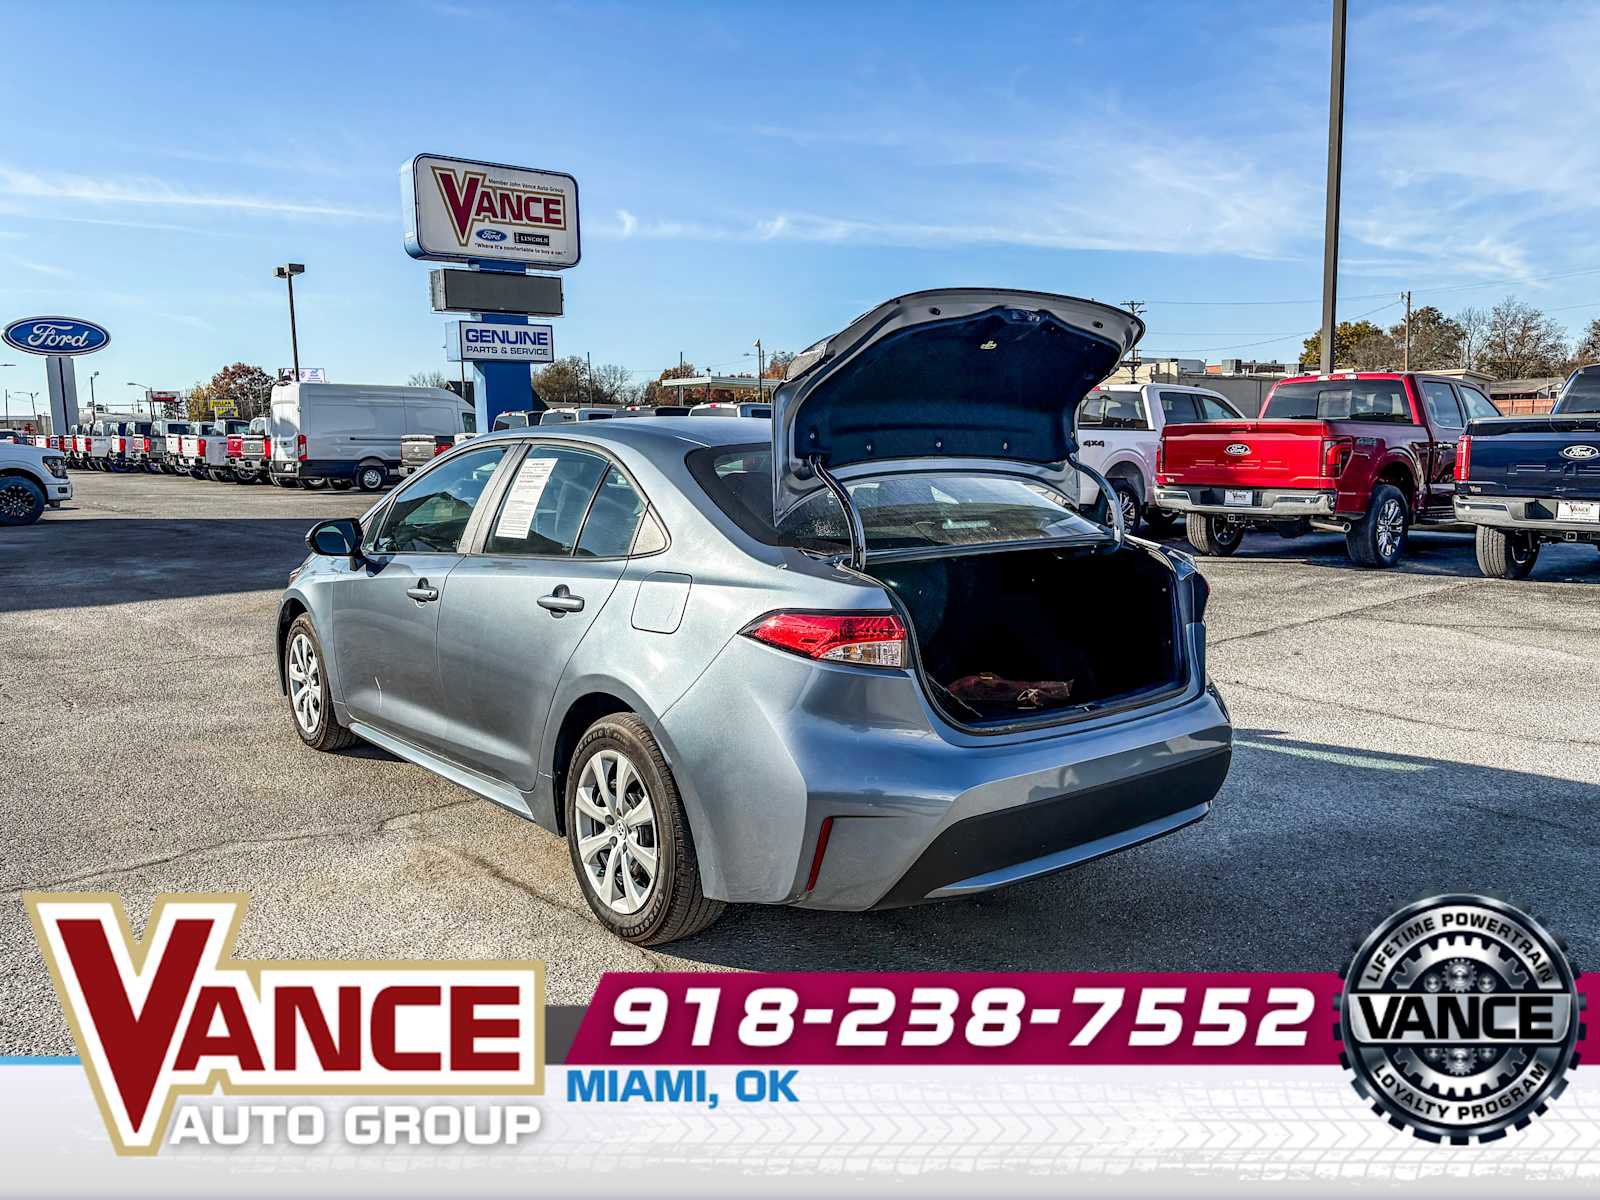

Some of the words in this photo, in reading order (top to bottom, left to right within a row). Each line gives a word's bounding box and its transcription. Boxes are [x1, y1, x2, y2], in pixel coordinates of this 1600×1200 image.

[437, 171, 562, 241] VANCE
[481, 229, 502, 240] Ford
[27, 323, 90, 347] Ford
[465, 328, 548, 346] GENUINE
[466, 345, 498, 354] PARTS
[510, 347, 549, 356] SERVICE
[1569, 446, 1592, 457] Ford
